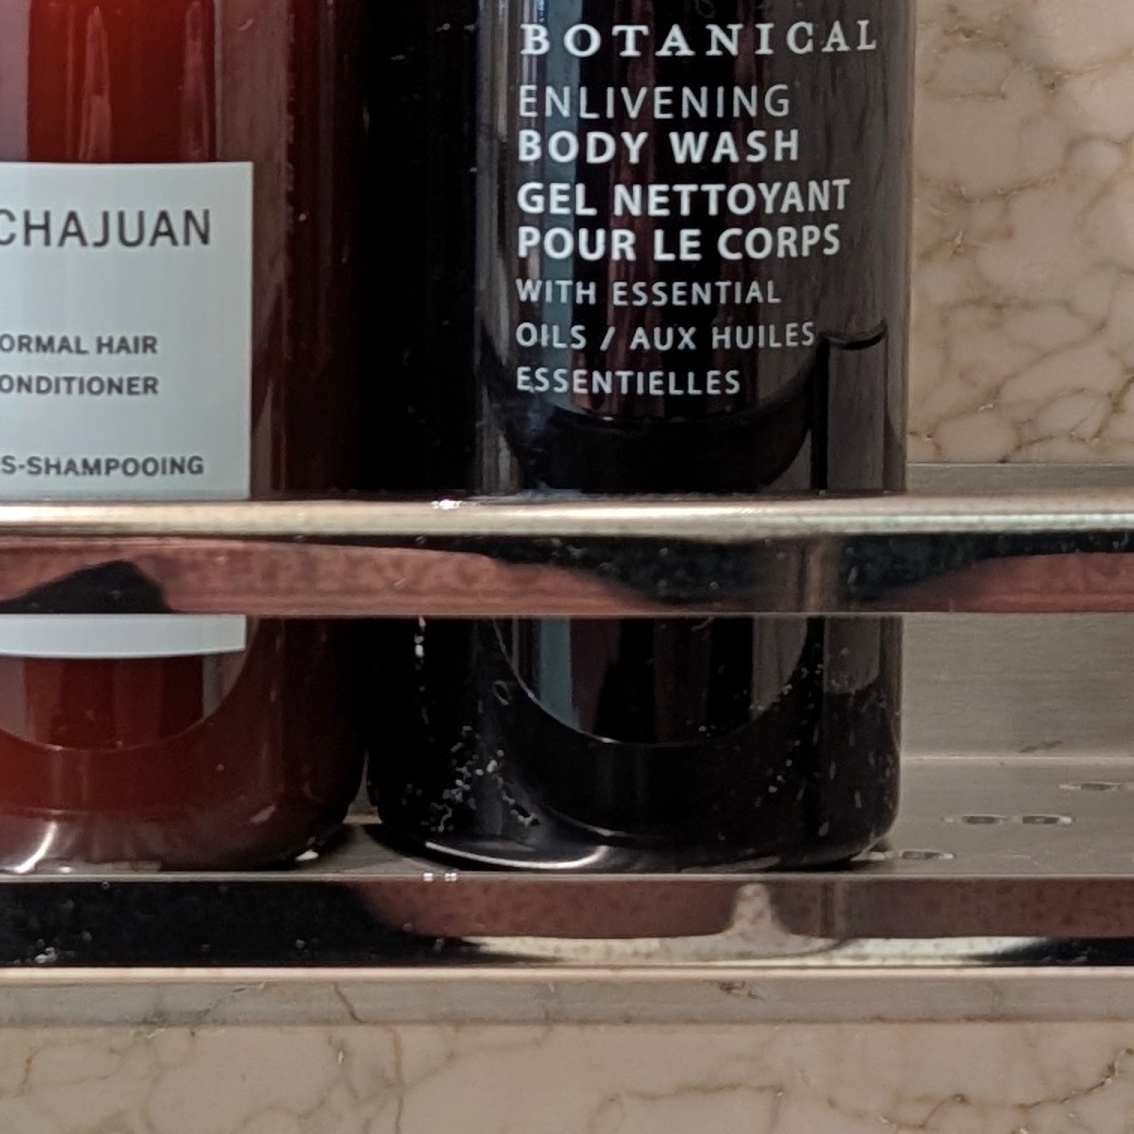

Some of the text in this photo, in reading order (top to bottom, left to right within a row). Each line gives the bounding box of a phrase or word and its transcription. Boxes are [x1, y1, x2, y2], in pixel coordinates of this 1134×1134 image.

[519, 20, 877, 58] BOTANICAL
[519, 83, 791, 119] ENLIVENING
[517, 128, 800, 165] BODY WASH
[516, 178, 851, 217] GEL NETTOYANT
[516, 223, 841, 262] POUR LE CORPS
[515, 278, 782, 307] WITH ESSENTIAL
[95, 334, 159, 356] HAIR
[515, 321, 816, 351] OILS / AUX HUILES
[516, 367, 741, 395] ESSENTIELLES
